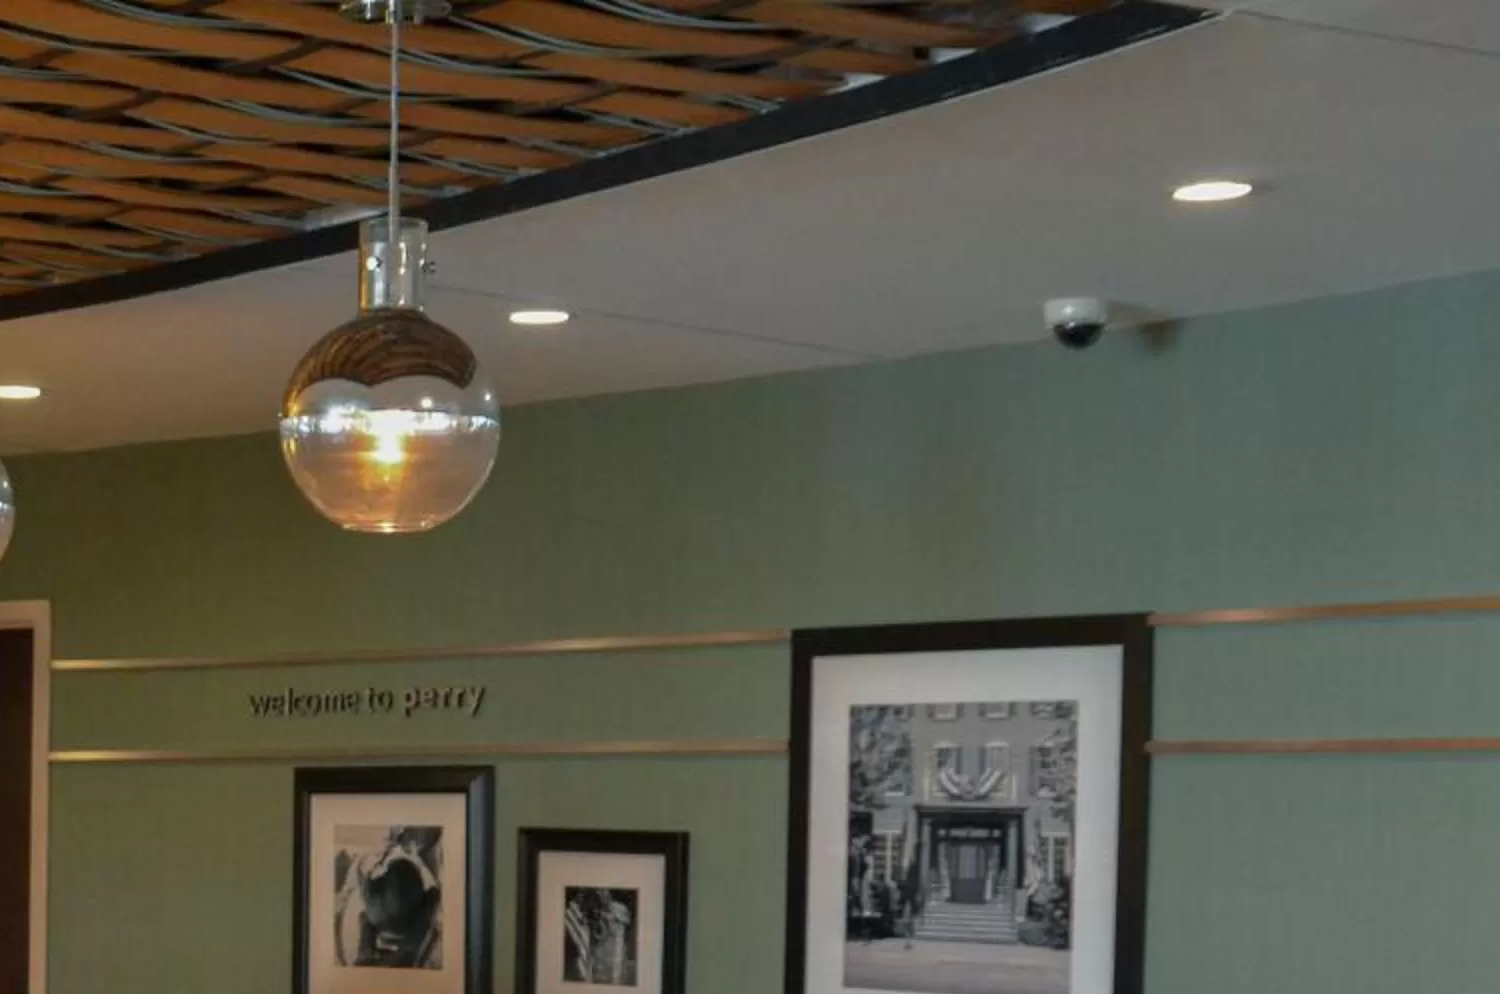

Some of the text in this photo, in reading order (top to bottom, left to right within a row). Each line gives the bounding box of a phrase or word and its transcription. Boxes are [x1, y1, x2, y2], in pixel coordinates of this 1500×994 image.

[250, 685, 486, 718] welcome to perry
